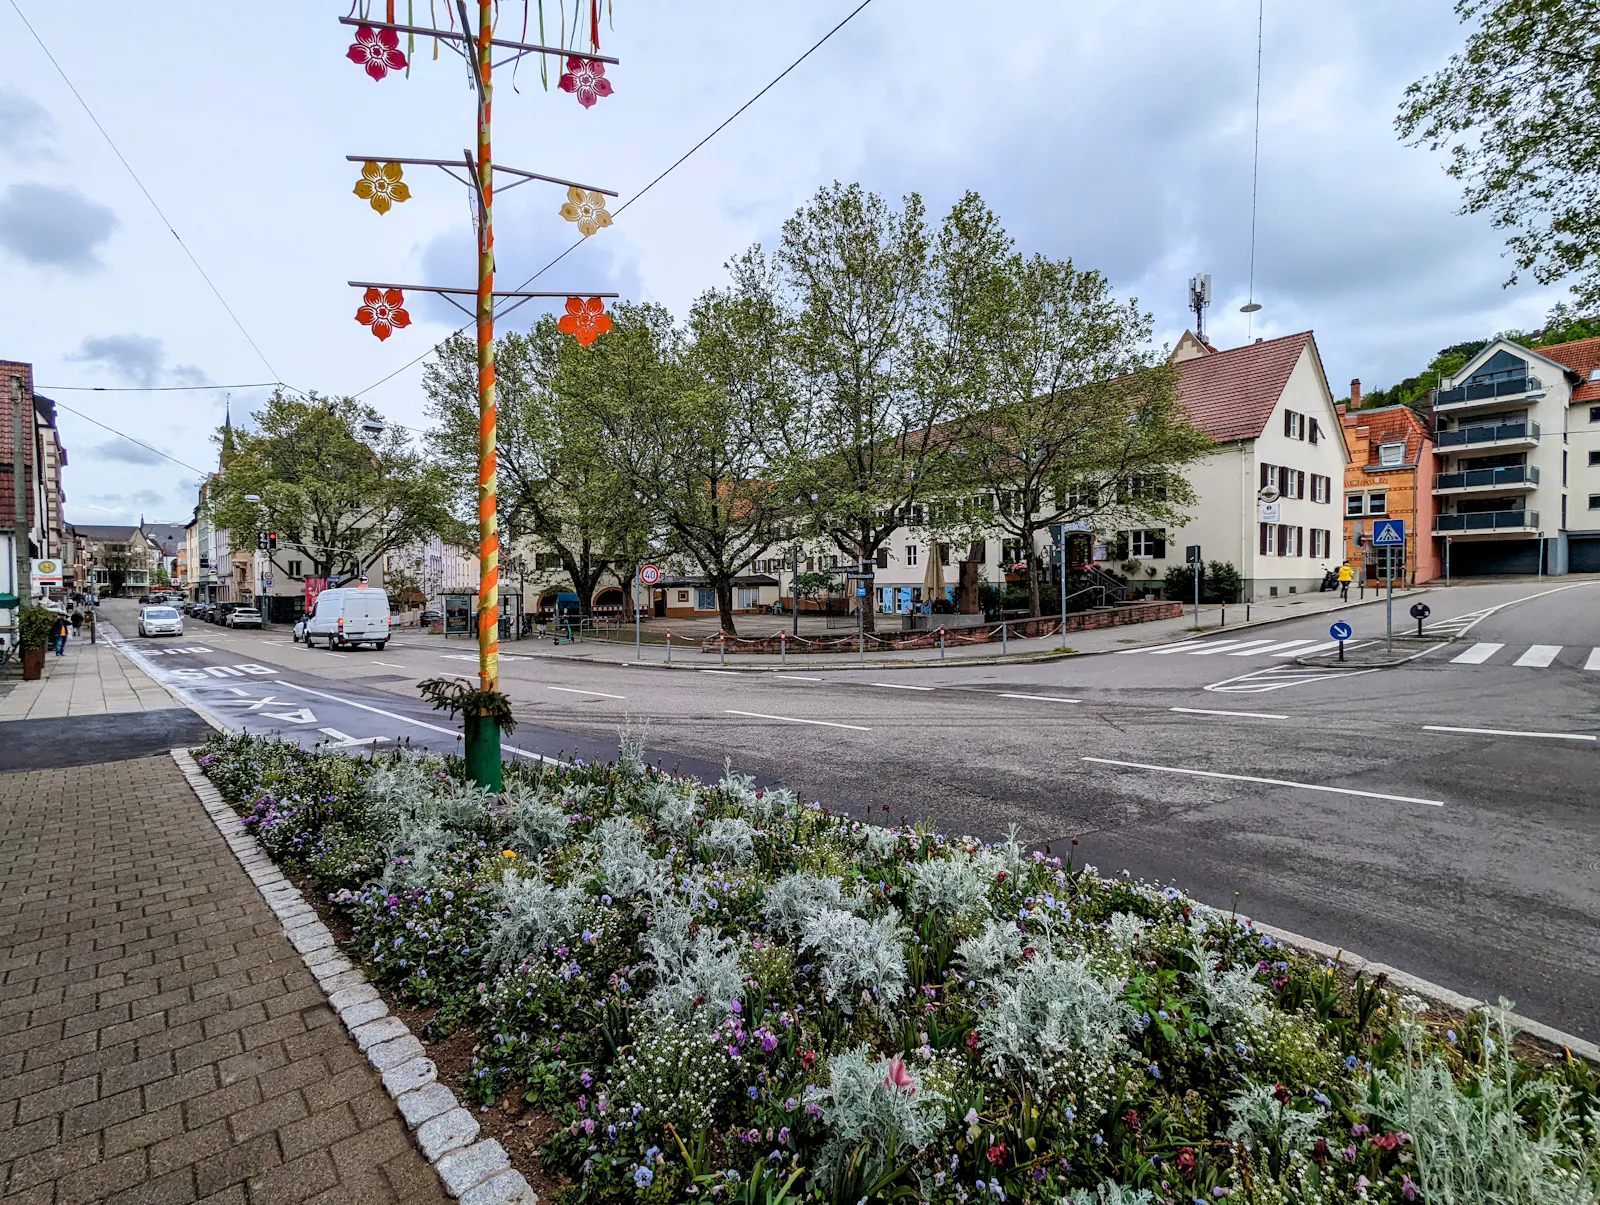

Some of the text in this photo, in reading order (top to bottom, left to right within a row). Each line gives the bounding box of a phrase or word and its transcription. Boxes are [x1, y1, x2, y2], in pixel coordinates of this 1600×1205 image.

[644, 570, 656, 579] 40
[141, 646, 214, 656] BUS
[169, 663, 280, 681] BUS
[231, 687, 393, 748] TAXI
